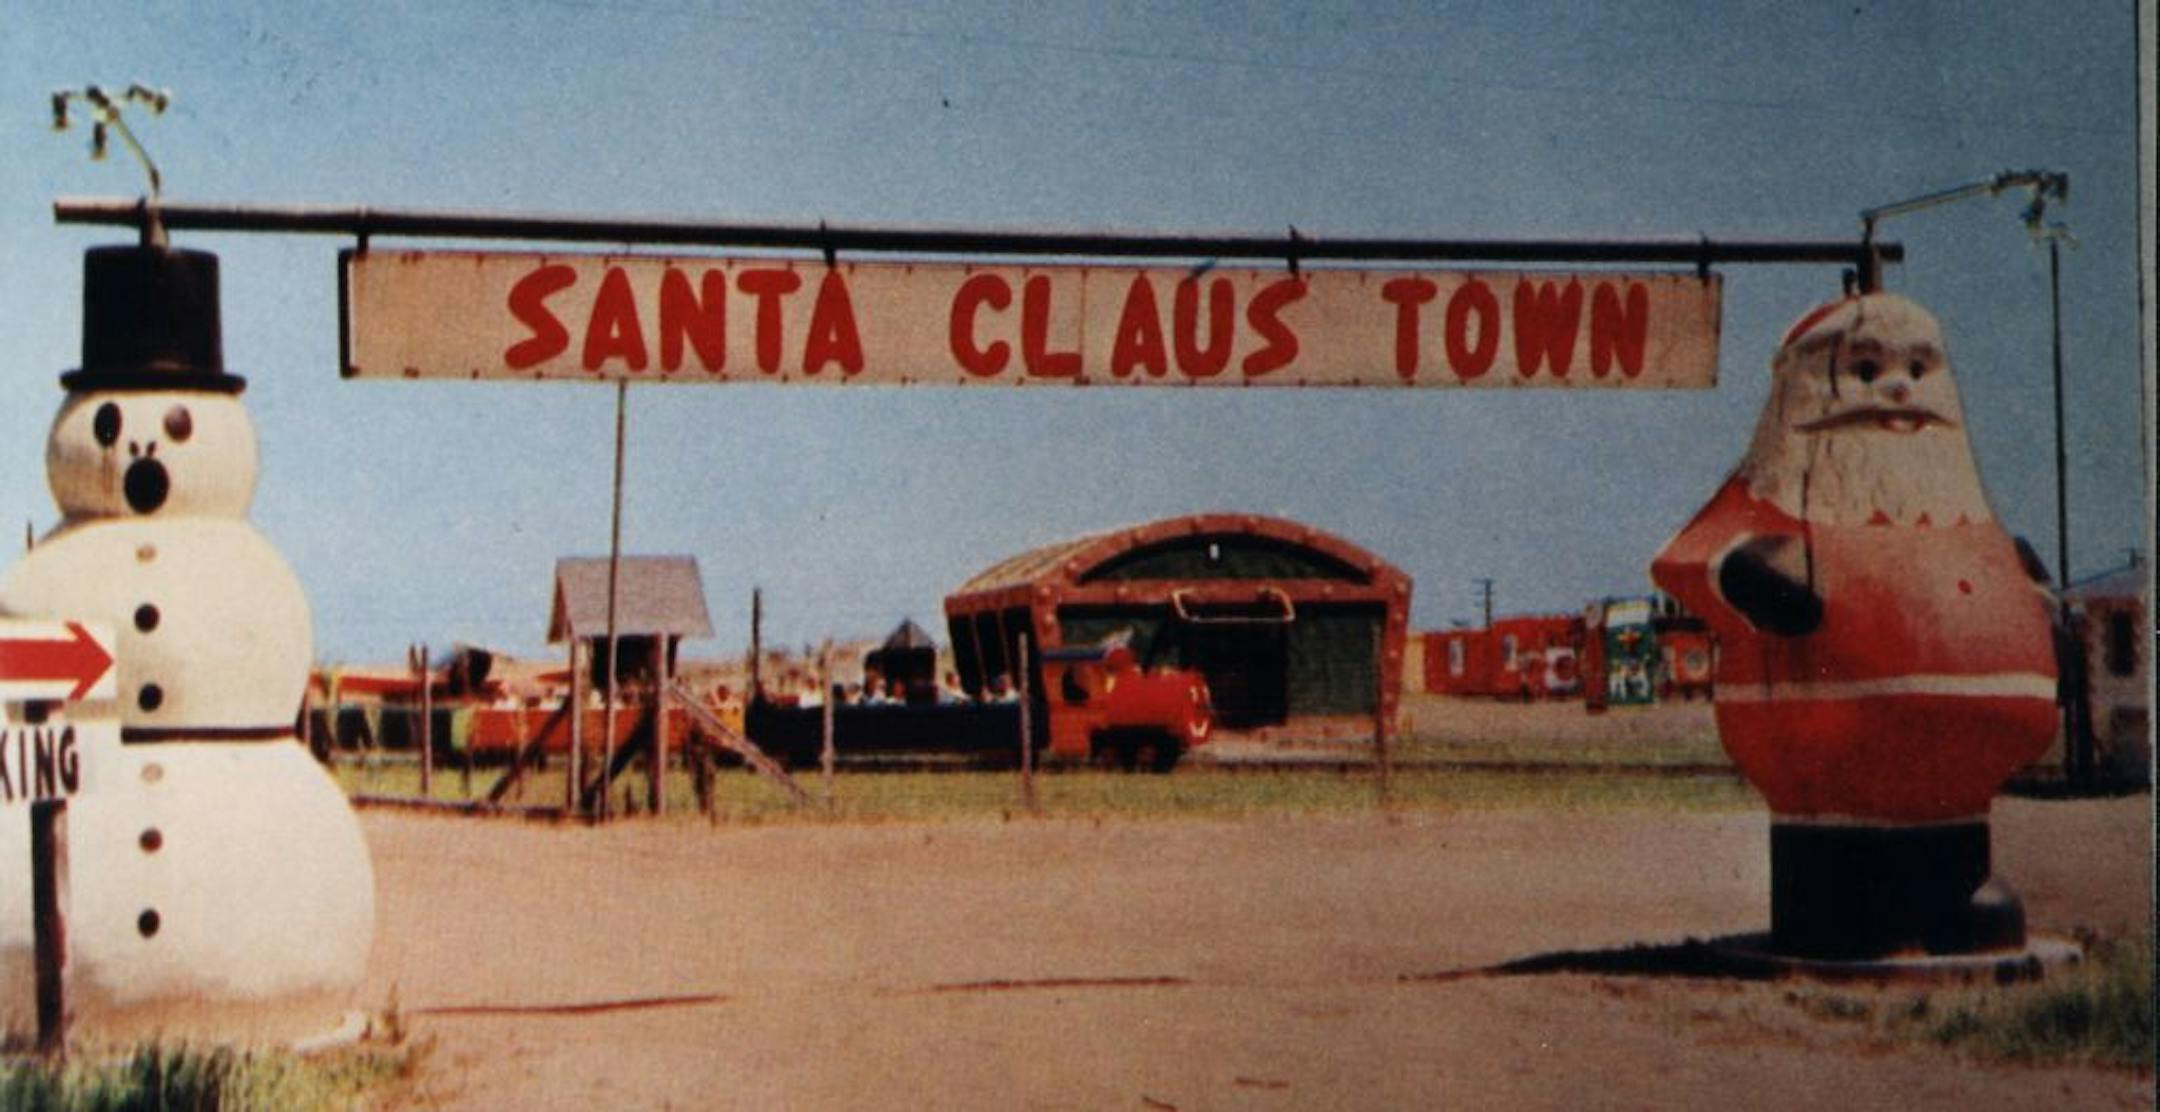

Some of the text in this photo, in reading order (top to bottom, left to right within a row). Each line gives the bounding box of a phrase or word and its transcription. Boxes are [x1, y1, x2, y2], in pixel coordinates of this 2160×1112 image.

[506, 265, 1649, 381] SANTA CLAUS TOWN
